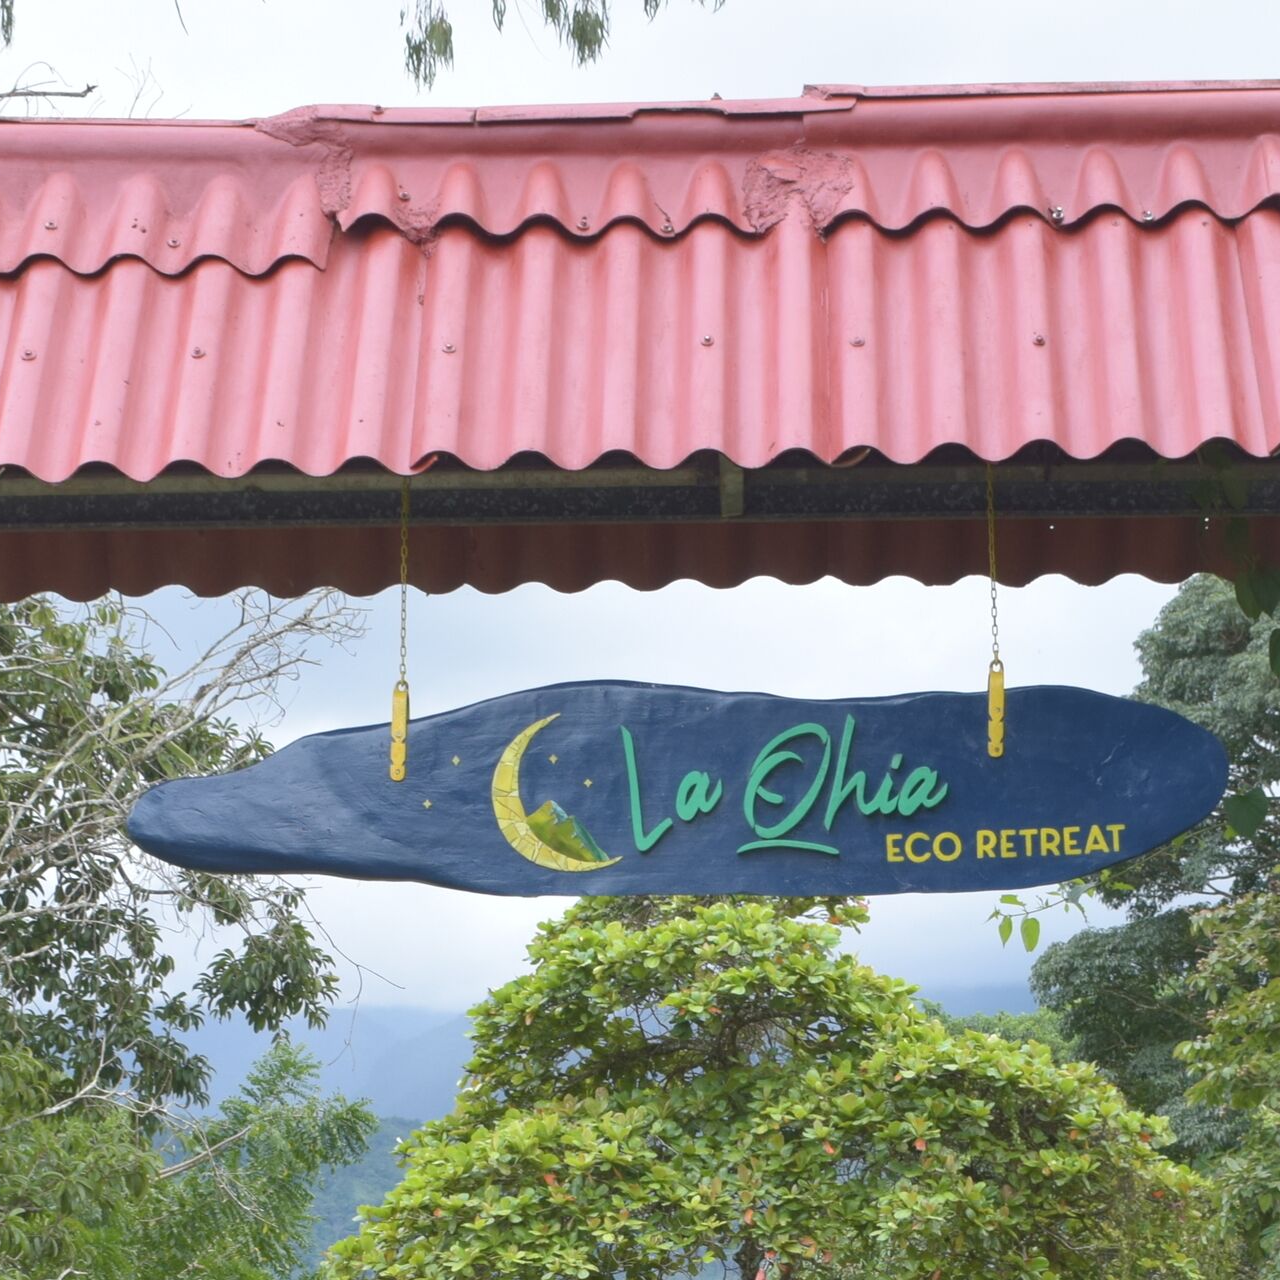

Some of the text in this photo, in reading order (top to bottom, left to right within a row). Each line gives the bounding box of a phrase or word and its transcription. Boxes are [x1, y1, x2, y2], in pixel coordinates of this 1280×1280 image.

[619, 713, 949, 852] La Ohia
[885, 823, 1127, 864] ECO RETREAT
